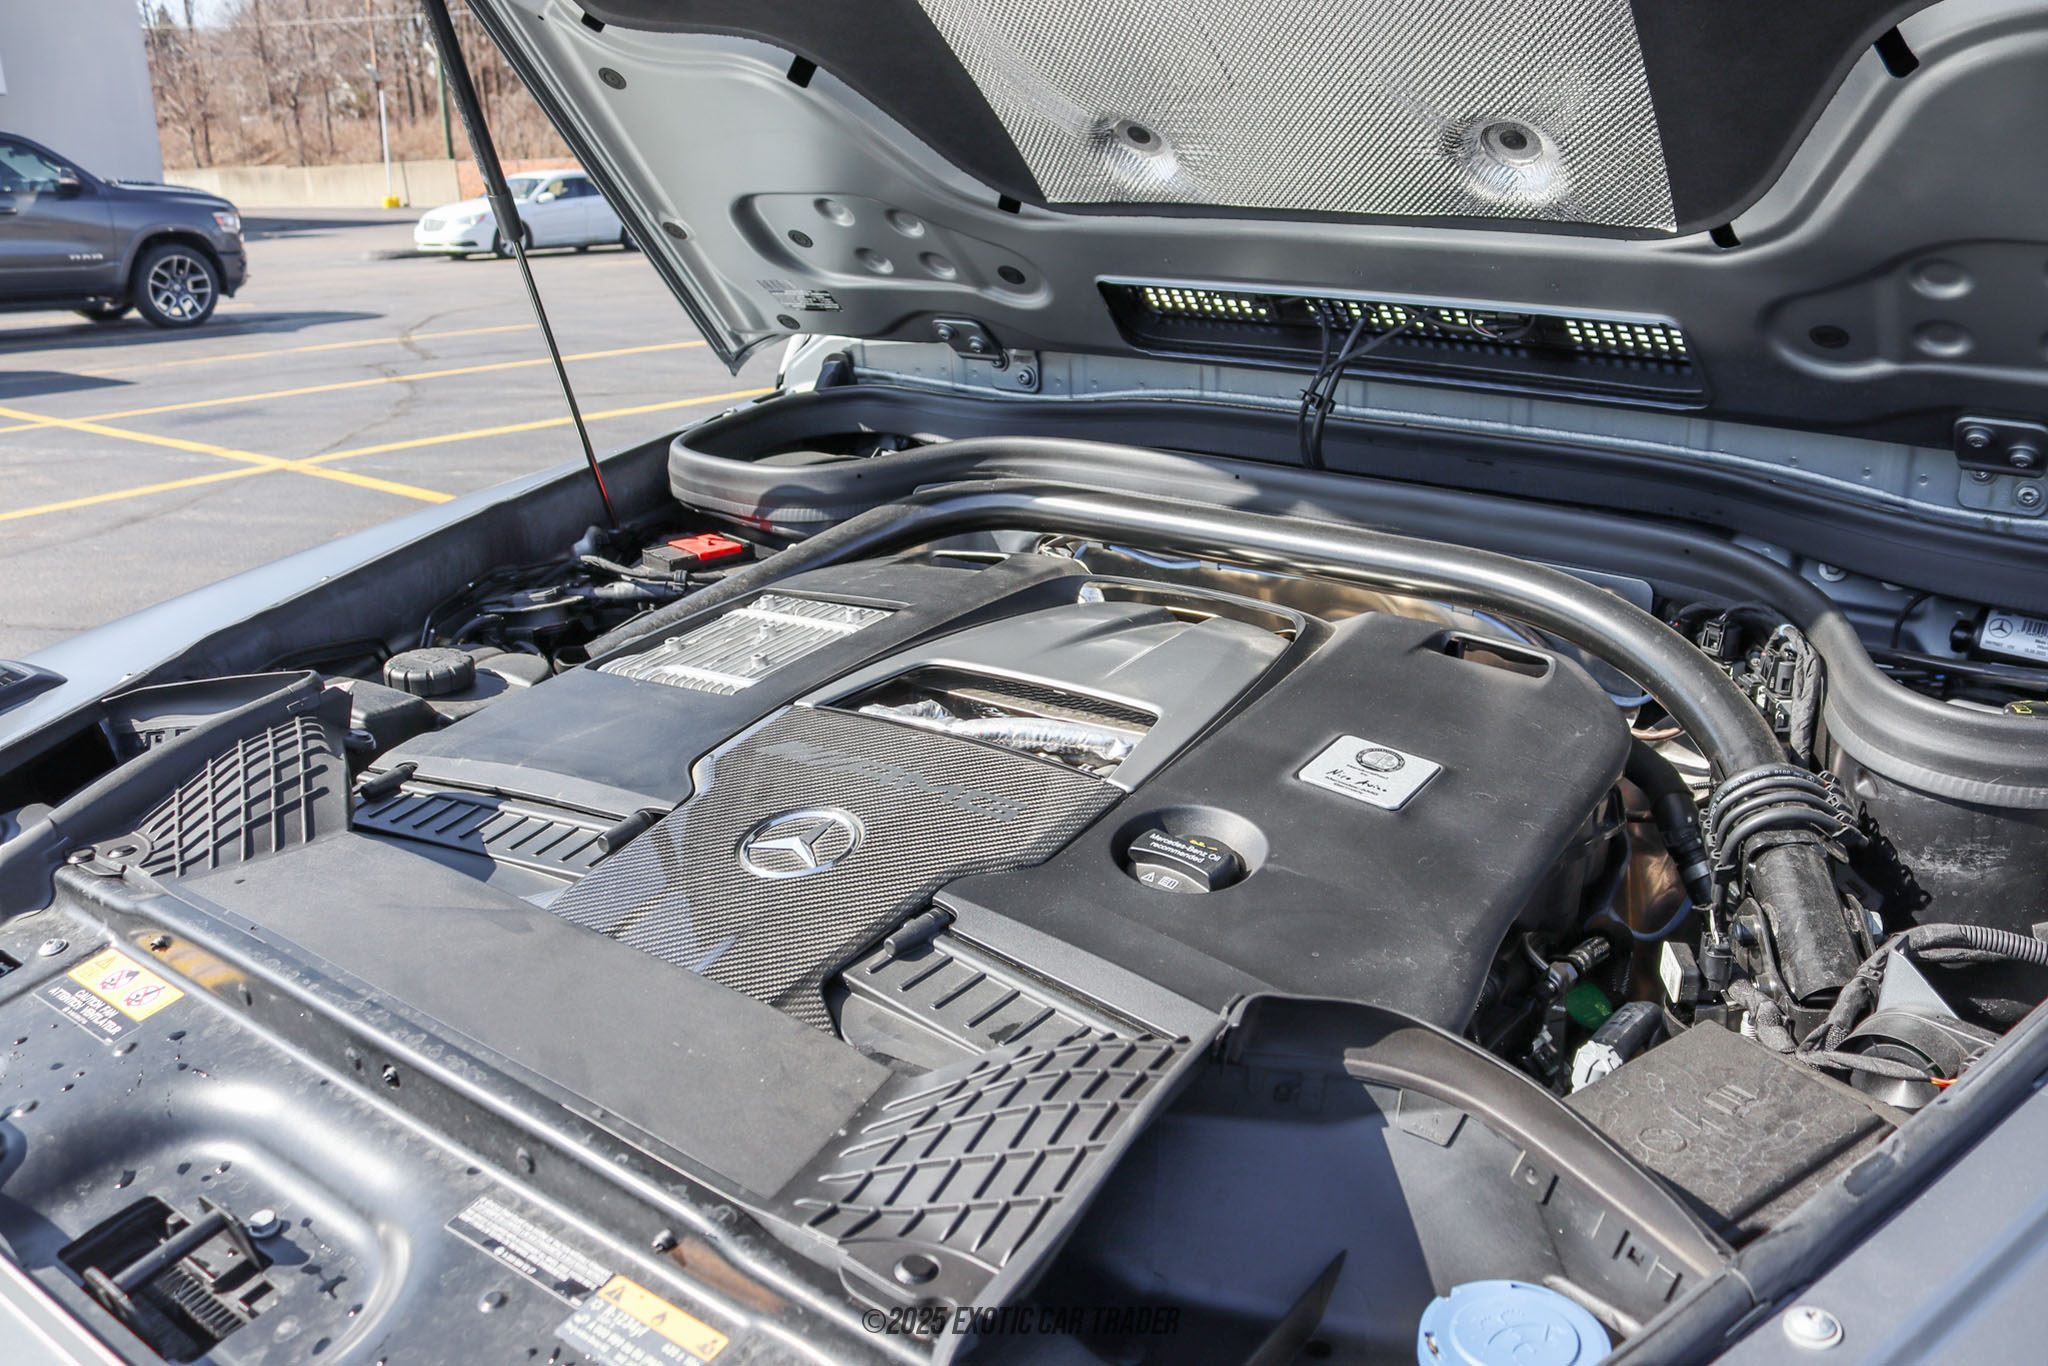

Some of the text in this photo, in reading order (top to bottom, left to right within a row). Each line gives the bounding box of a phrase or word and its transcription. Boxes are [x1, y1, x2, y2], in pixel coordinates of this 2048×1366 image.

[69, 252, 104, 260] RAM
[831, 759, 1029, 822] AMG
[1149, 833, 1221, 862] Mercedes-Benz Oil
[1149, 842, 1205, 864] recommended
[48, 986, 84, 1012] ATTENTION
[80, 1005, 122, 1035] VENTILATEUR
[75, 989, 102, 1011] CAUTION
[101, 1005, 120, 1019] FAN
